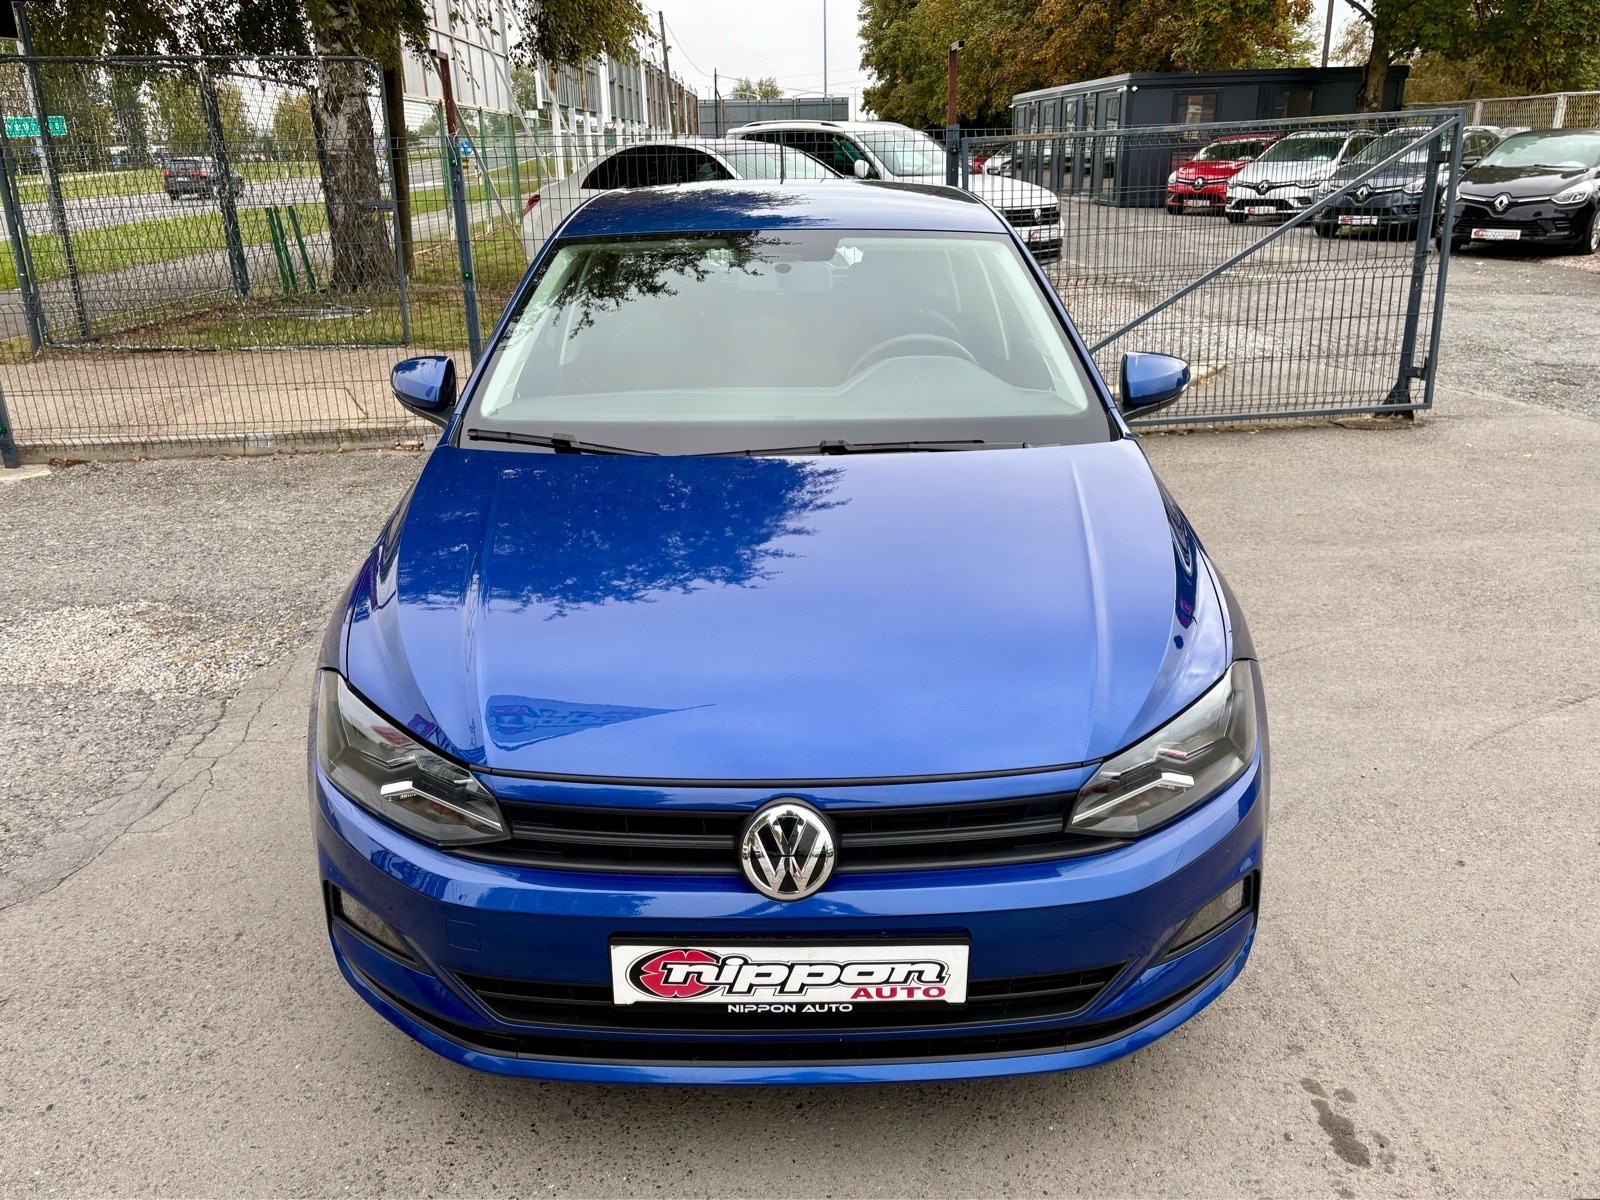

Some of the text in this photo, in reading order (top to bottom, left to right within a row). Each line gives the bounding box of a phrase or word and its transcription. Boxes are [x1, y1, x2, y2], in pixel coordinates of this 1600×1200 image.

[851, 986, 946, 999] AUTO
[728, 1003, 853, 1013] NIPPON AUTO
